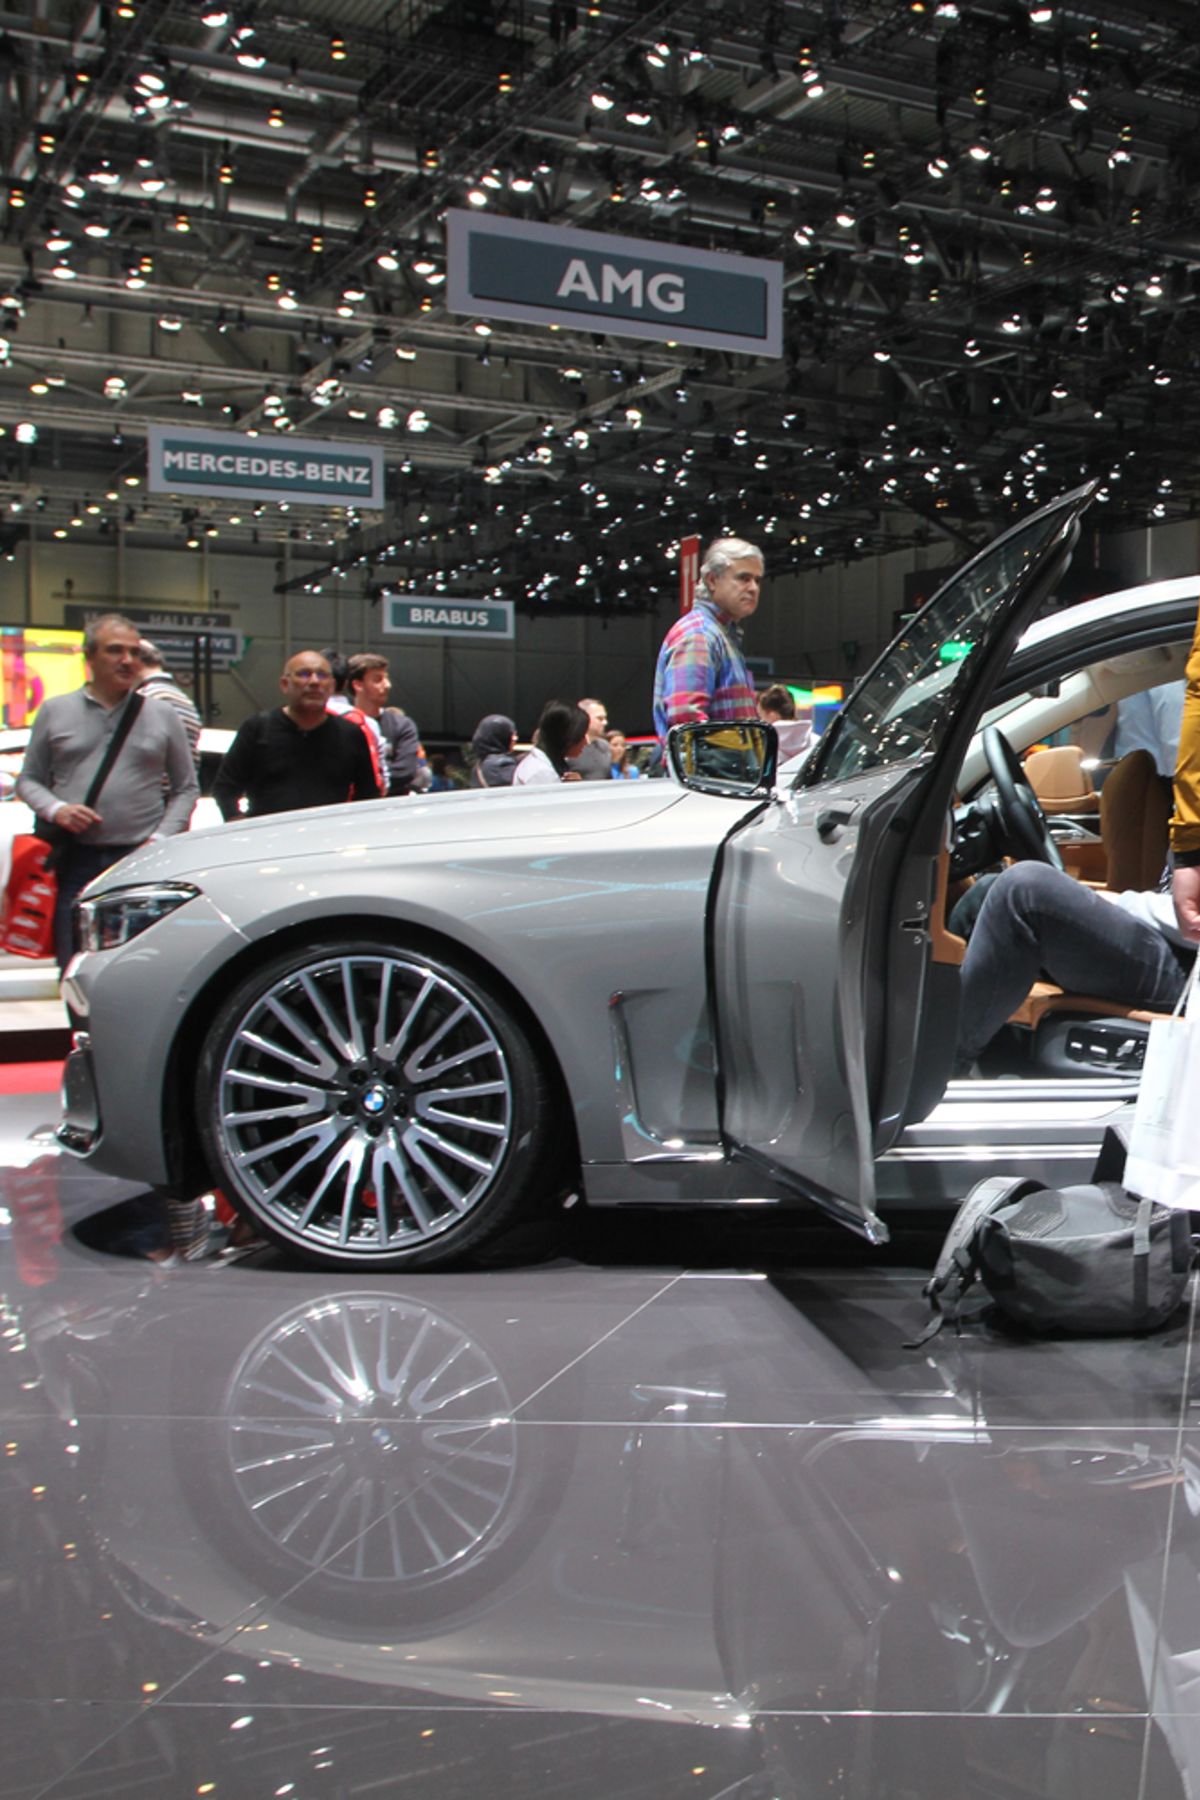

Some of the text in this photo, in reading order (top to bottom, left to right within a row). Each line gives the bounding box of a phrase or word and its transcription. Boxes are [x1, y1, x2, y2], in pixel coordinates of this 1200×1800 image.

[556, 258, 686, 314] AMG
[163, 451, 371, 485] MERCEDES-BENZ
[410, 607, 489, 626] BRABUS
